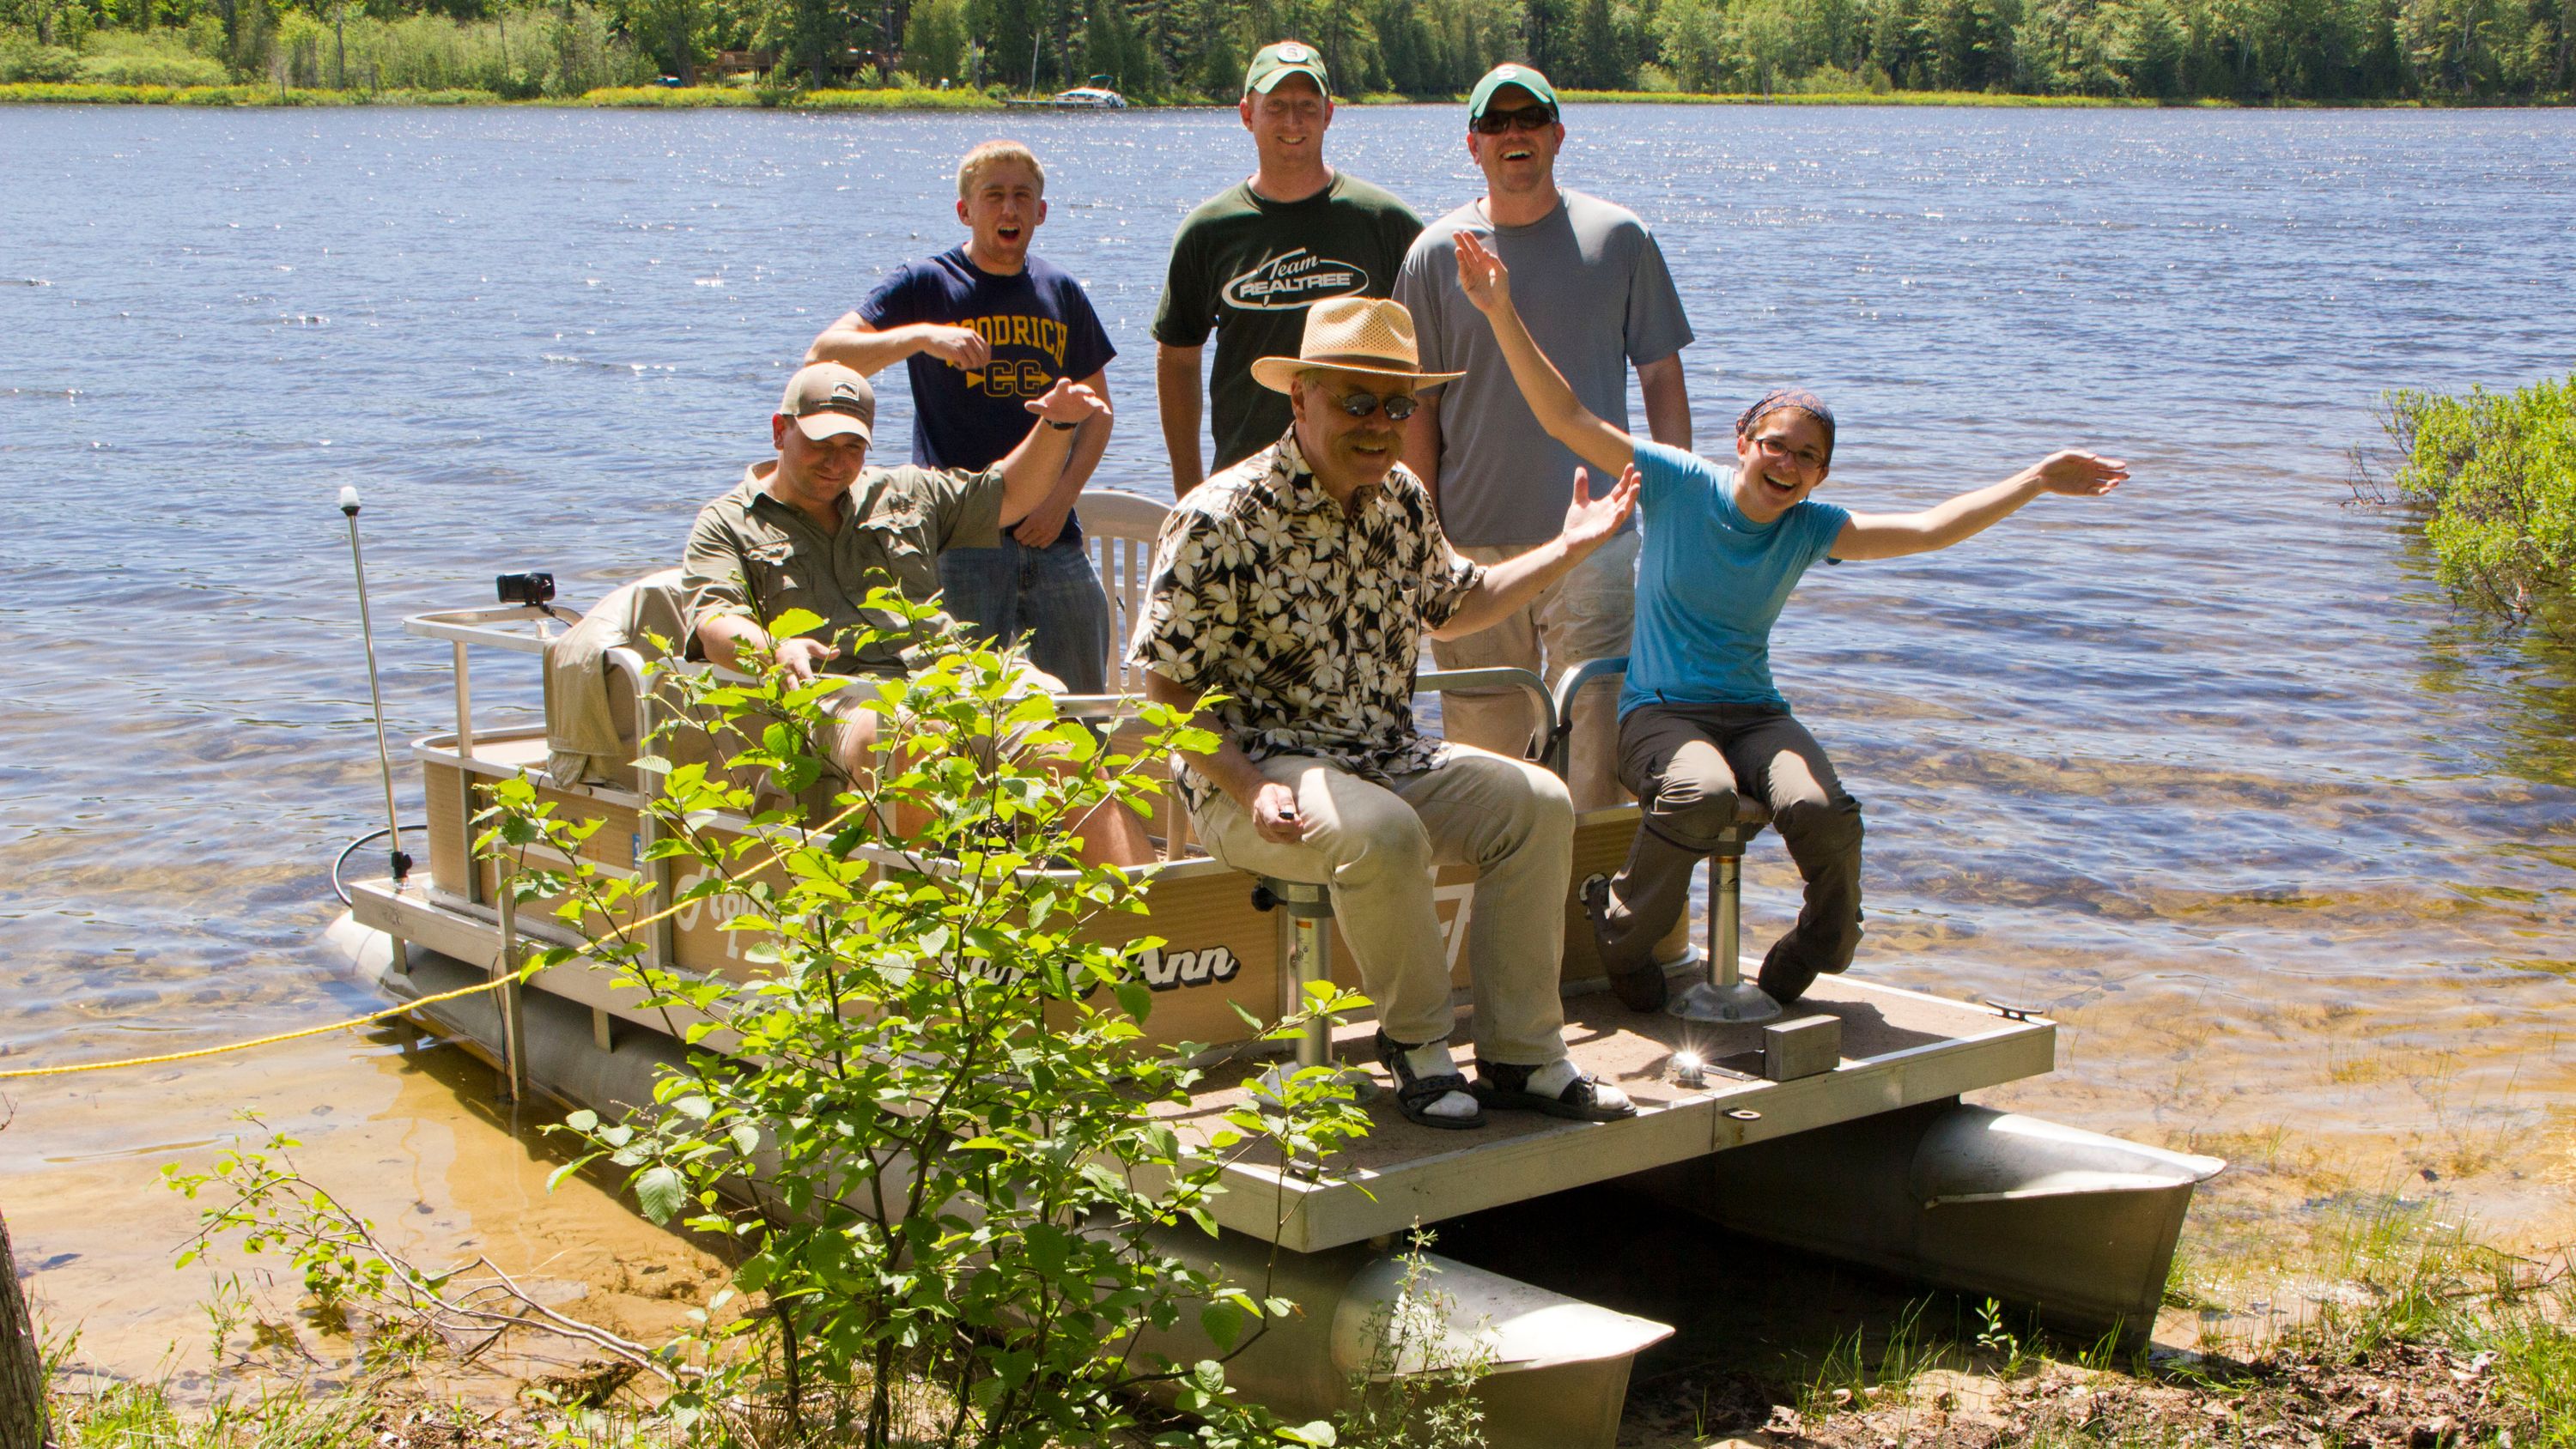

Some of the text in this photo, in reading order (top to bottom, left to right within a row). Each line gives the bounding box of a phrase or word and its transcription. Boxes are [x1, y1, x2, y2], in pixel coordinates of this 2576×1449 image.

[1268, 256, 1319, 280] Team
[1239, 273, 1352, 298] REALTREE
[945, 315, 1068, 369] ODRICH
